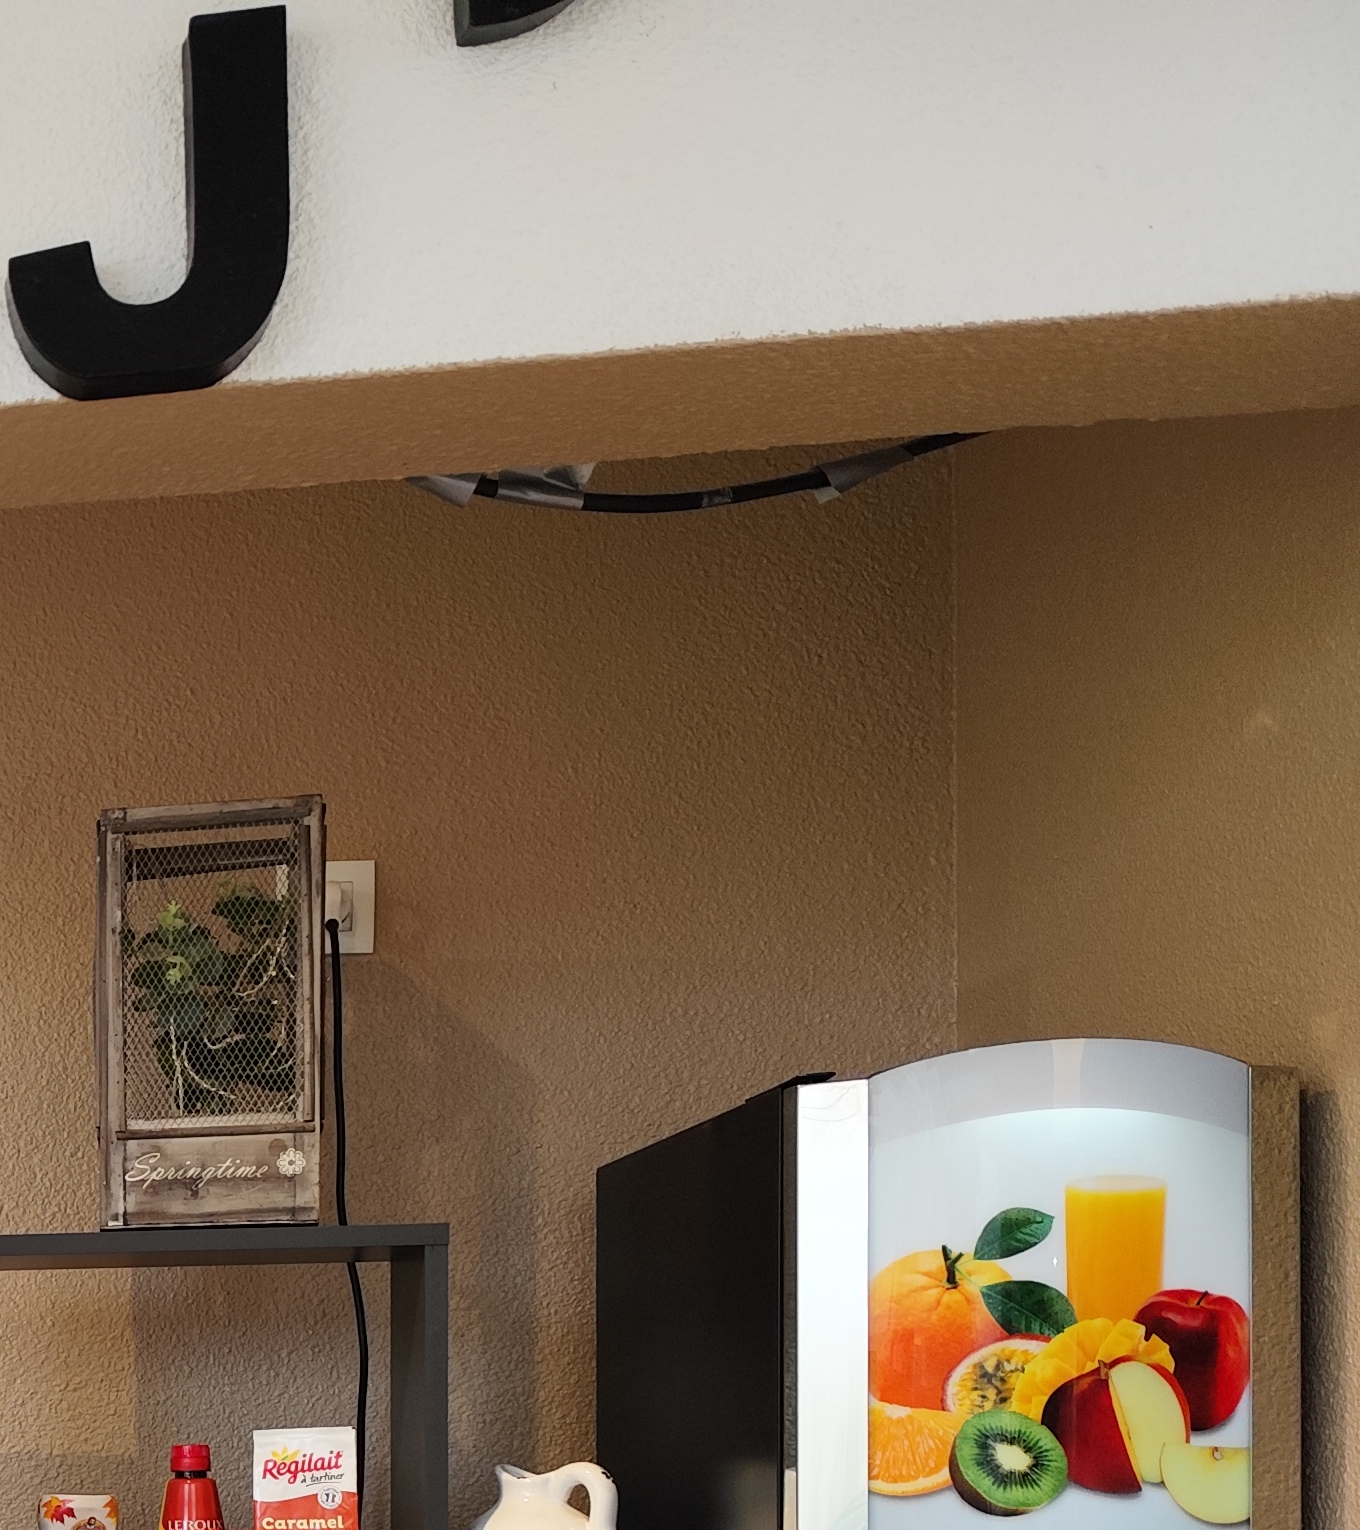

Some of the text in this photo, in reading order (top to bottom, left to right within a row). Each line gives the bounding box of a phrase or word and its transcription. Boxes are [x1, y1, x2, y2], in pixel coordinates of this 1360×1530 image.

[124, 1152, 269, 1190] Springtime
[310, 1471, 345, 1483] tartiner
[168, 1520, 224, 1530] LEROUX
[262, 1515, 344, 1530] Caramel
